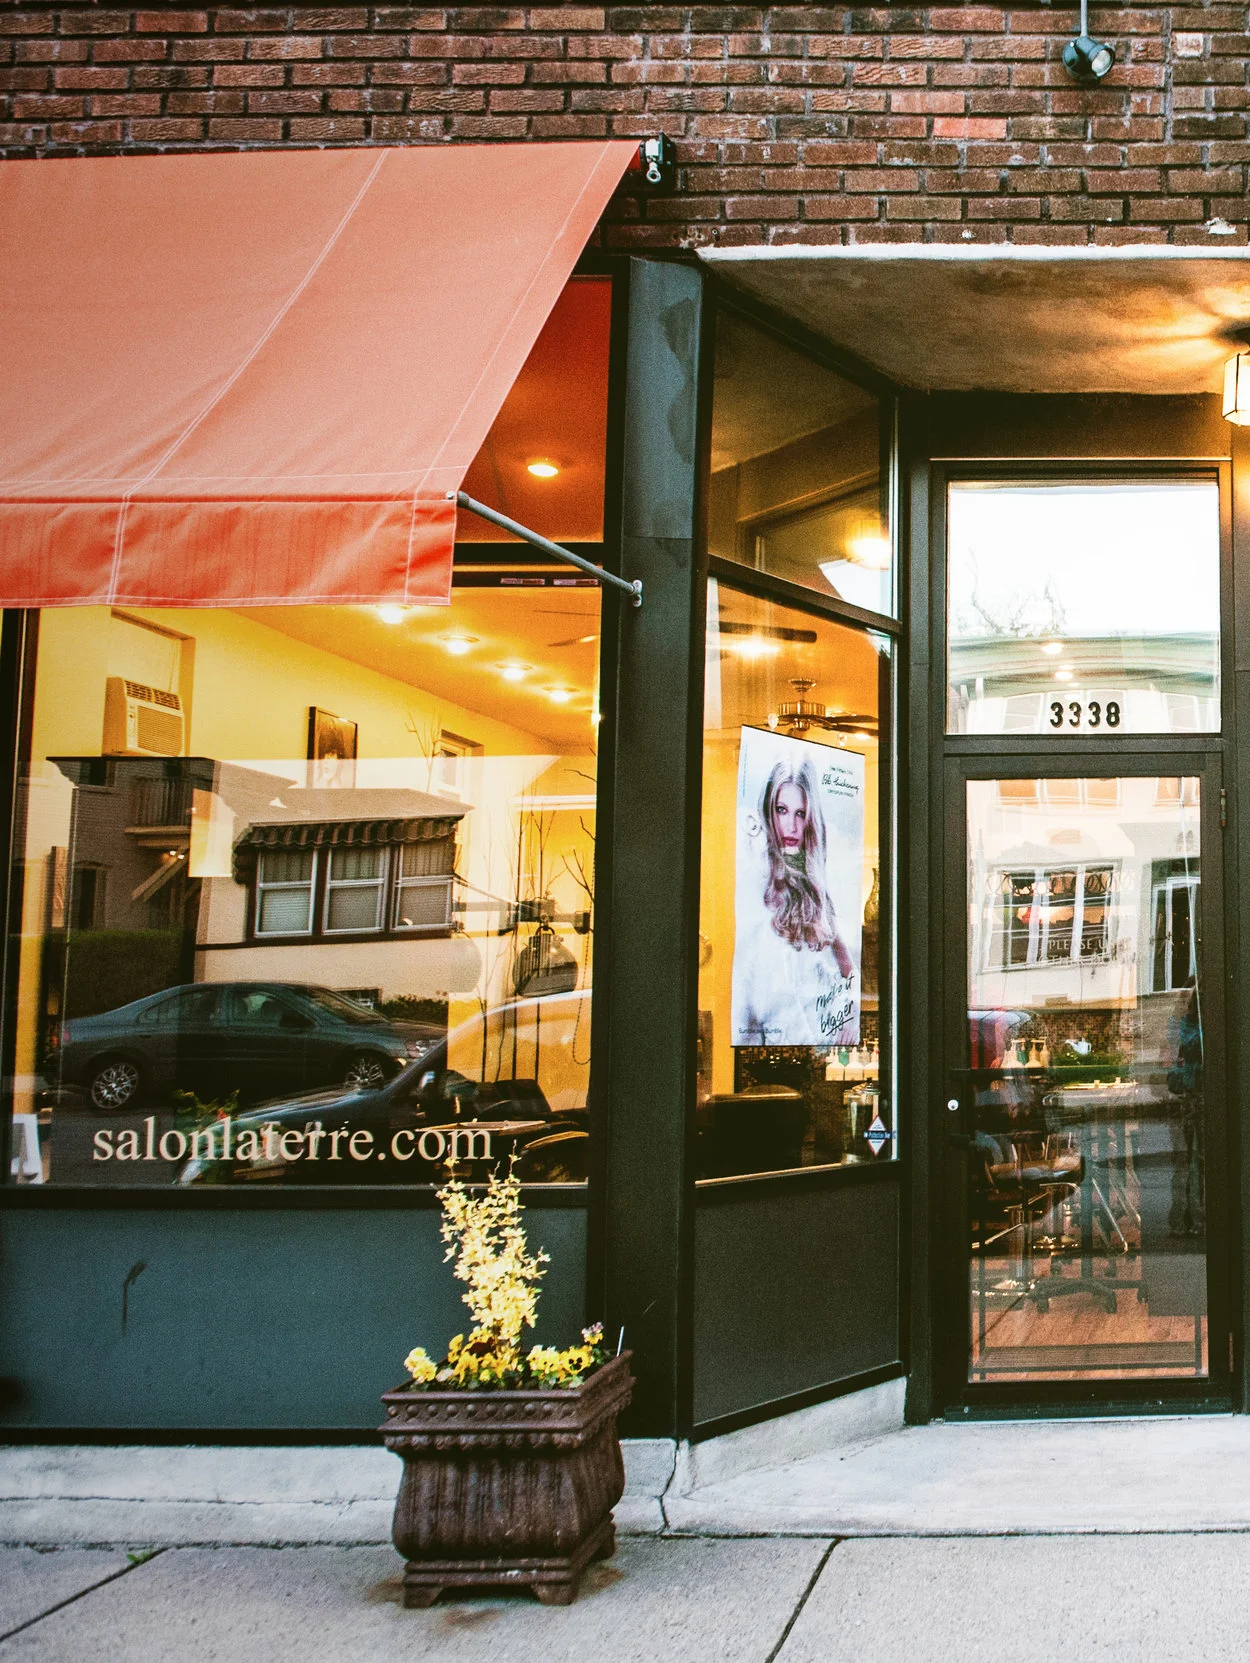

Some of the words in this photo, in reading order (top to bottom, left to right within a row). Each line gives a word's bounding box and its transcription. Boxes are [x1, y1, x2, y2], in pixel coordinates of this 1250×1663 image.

[1049, 700, 1121, 728] 3338
[1048, 938, 1093, 950] PLESE
[92, 1115, 495, 1161] salonlaterre.com
